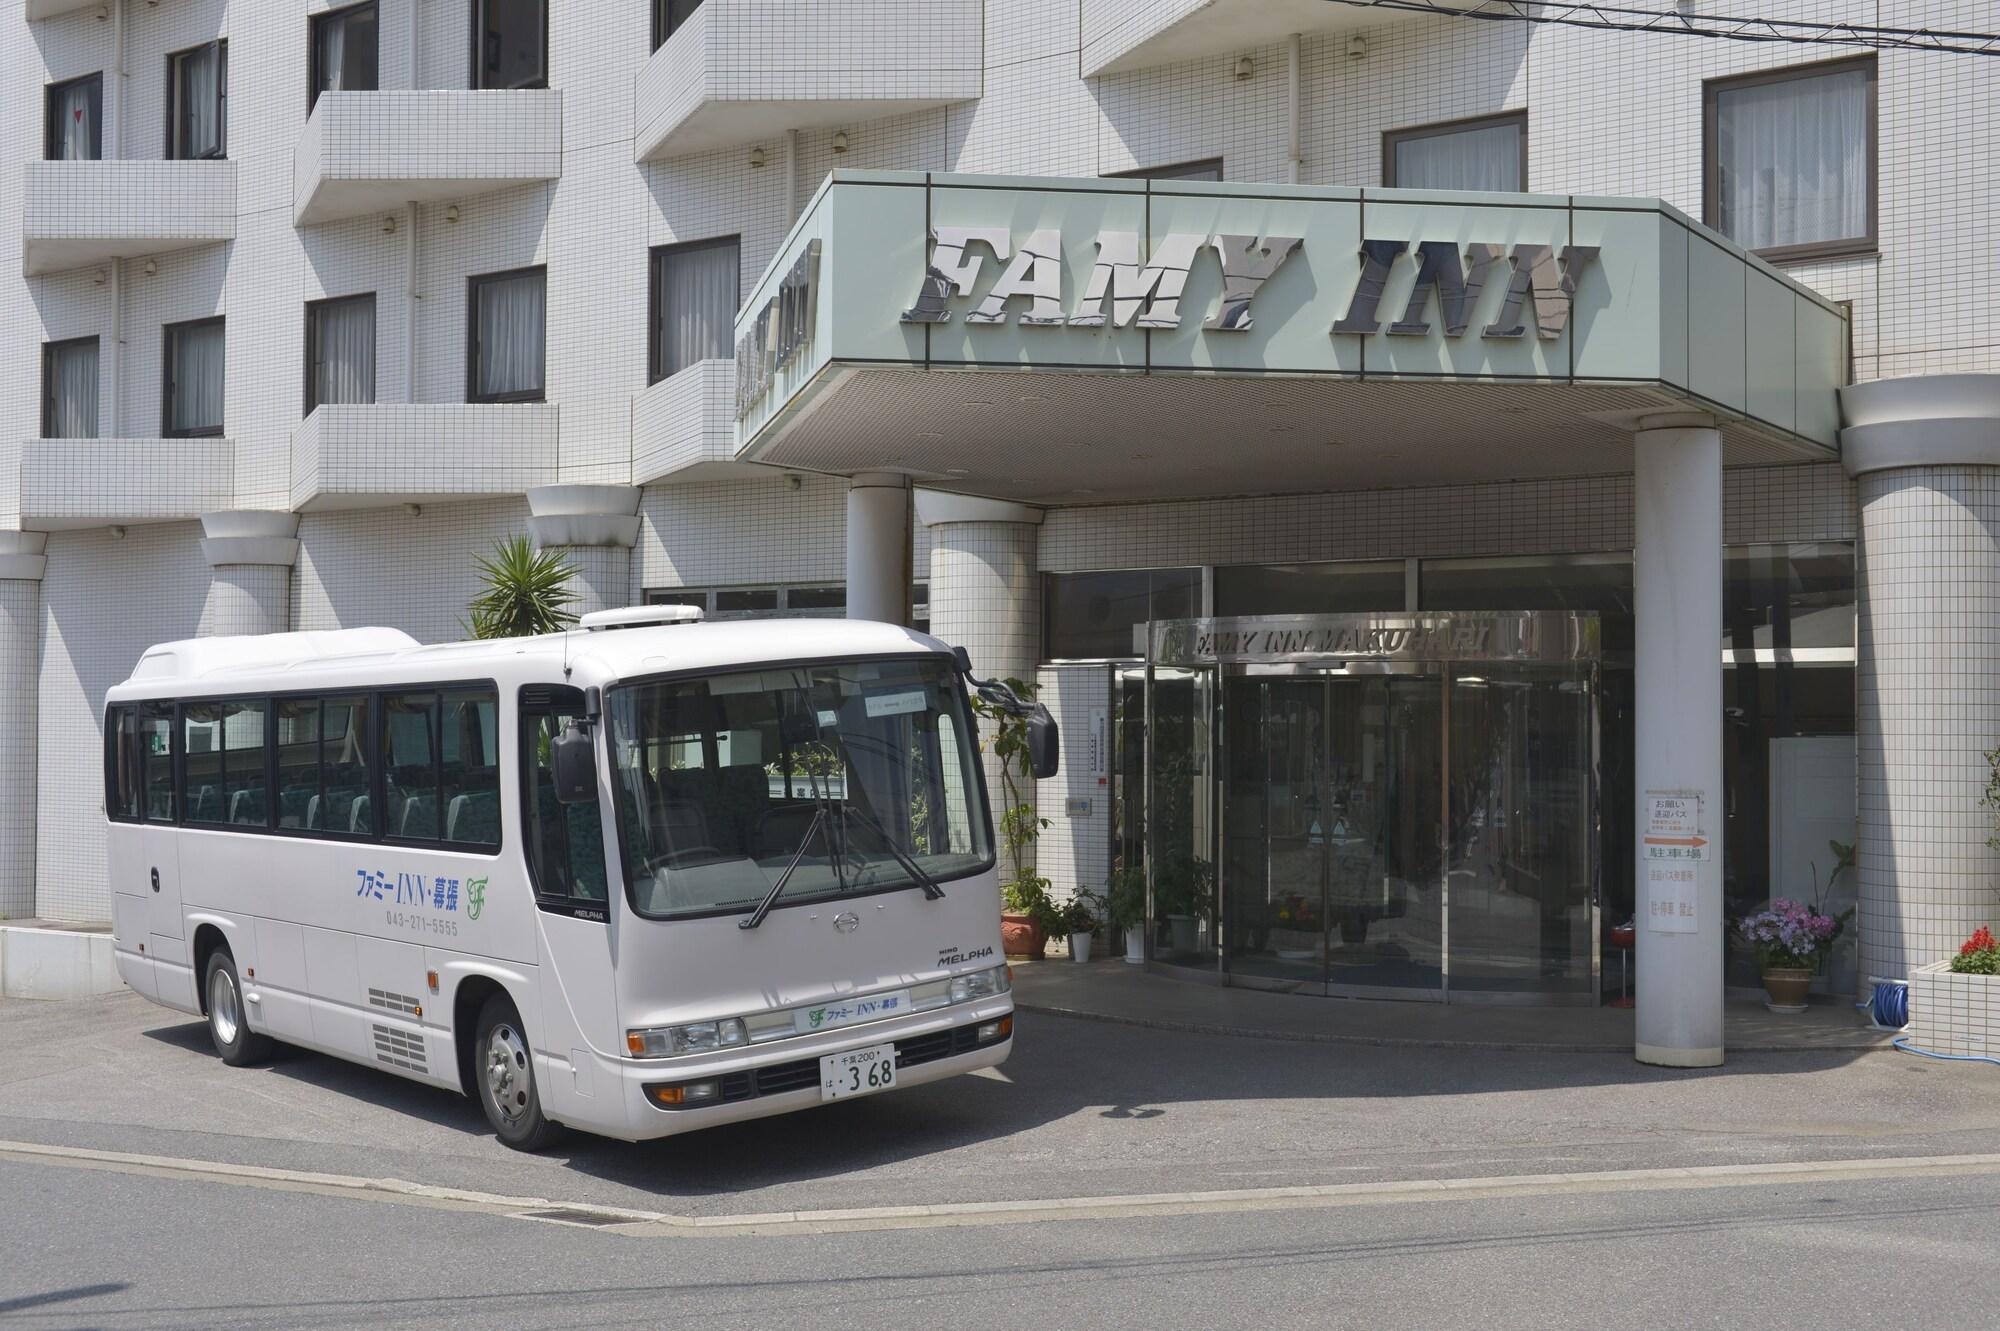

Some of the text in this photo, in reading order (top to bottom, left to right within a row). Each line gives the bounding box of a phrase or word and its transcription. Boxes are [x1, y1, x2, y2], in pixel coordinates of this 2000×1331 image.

[900, 227, 1304, 331] FAMY
[1330, 239, 1600, 339] INN
[1264, 629, 1313, 653] INN
[1319, 627, 1489, 653] MAKUHARI
[1656, 799, 1686, 808] お願い
[1649, 848, 1702, 859] 駐車場
[385, 910, 458, 937] 043-271-5555
[574, 909, 604, 920] MELPHA
[937, 945, 994, 967] MELPHA
